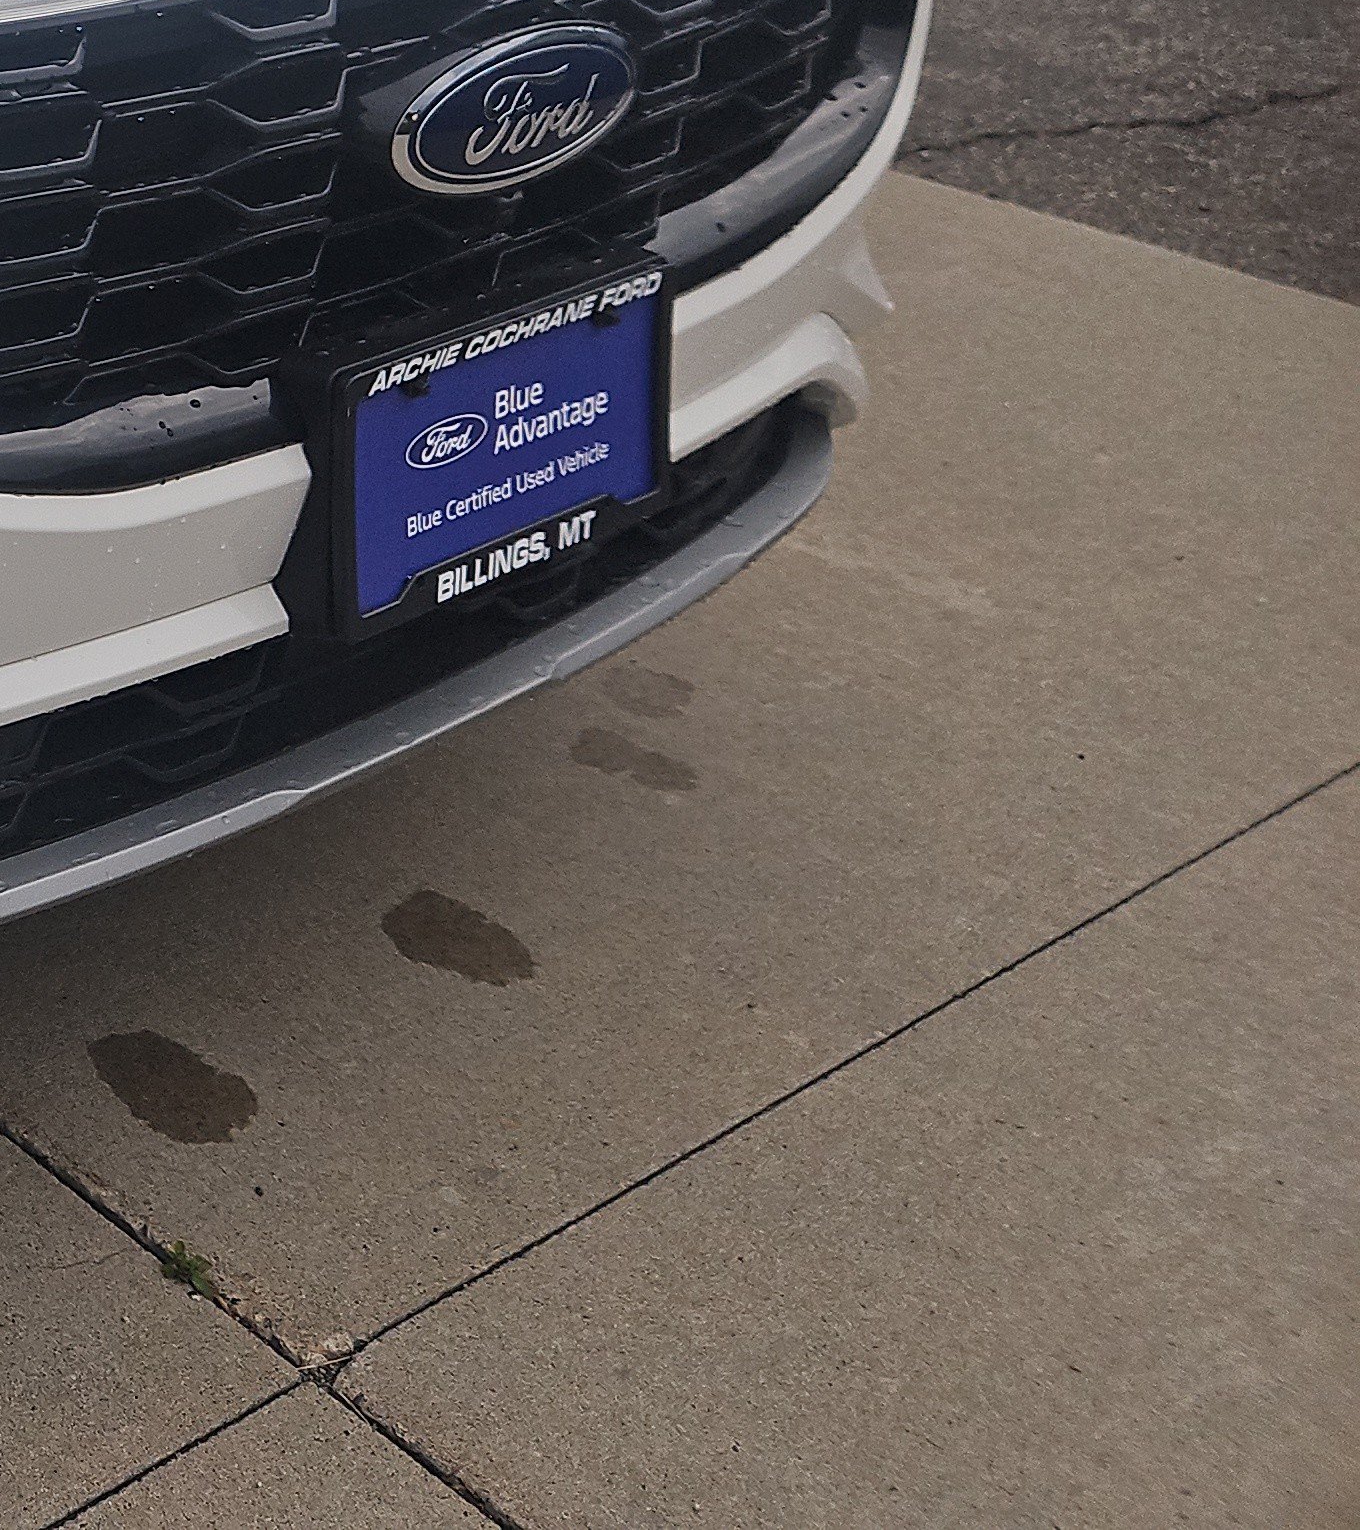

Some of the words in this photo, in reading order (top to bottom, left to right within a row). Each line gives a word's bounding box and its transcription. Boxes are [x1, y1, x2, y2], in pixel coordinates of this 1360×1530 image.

[464, 63, 600, 166] Ford
[368, 343, 464, 396] ARCHIE
[464, 294, 598, 360] COCHRANE
[598, 271, 663, 312] FORD
[421, 422, 474, 463] Ford
[493, 391, 610, 455] Advantage
[494, 382, 544, 419] Blue
[407, 512, 443, 538] Blue
[445, 477, 512, 521] Certified
[515, 461, 555, 494] Used
[556, 441, 610, 476] Vehicle
[437, 531, 551, 603] BILLINGS,
[558, 510, 597, 550] MT
